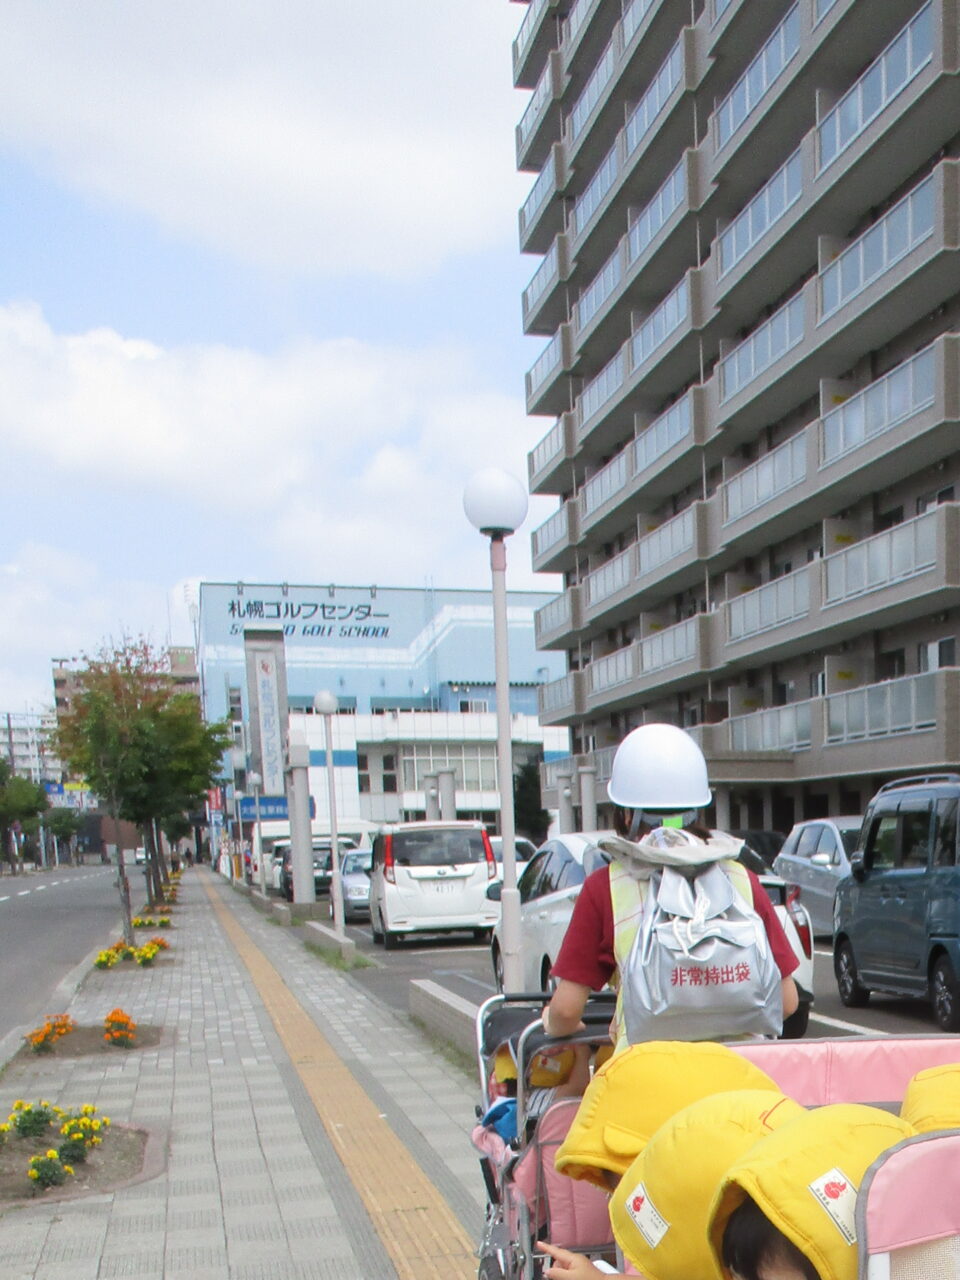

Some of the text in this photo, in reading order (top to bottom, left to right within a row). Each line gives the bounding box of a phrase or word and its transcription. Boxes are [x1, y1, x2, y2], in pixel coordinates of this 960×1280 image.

[228, 600, 389, 620] 札幌ゴルフセンター
[302, 624, 334, 637] GOLF
[339, 625, 390, 638] SCHOOL
[671, 962, 751, 986] 非常持出袋
